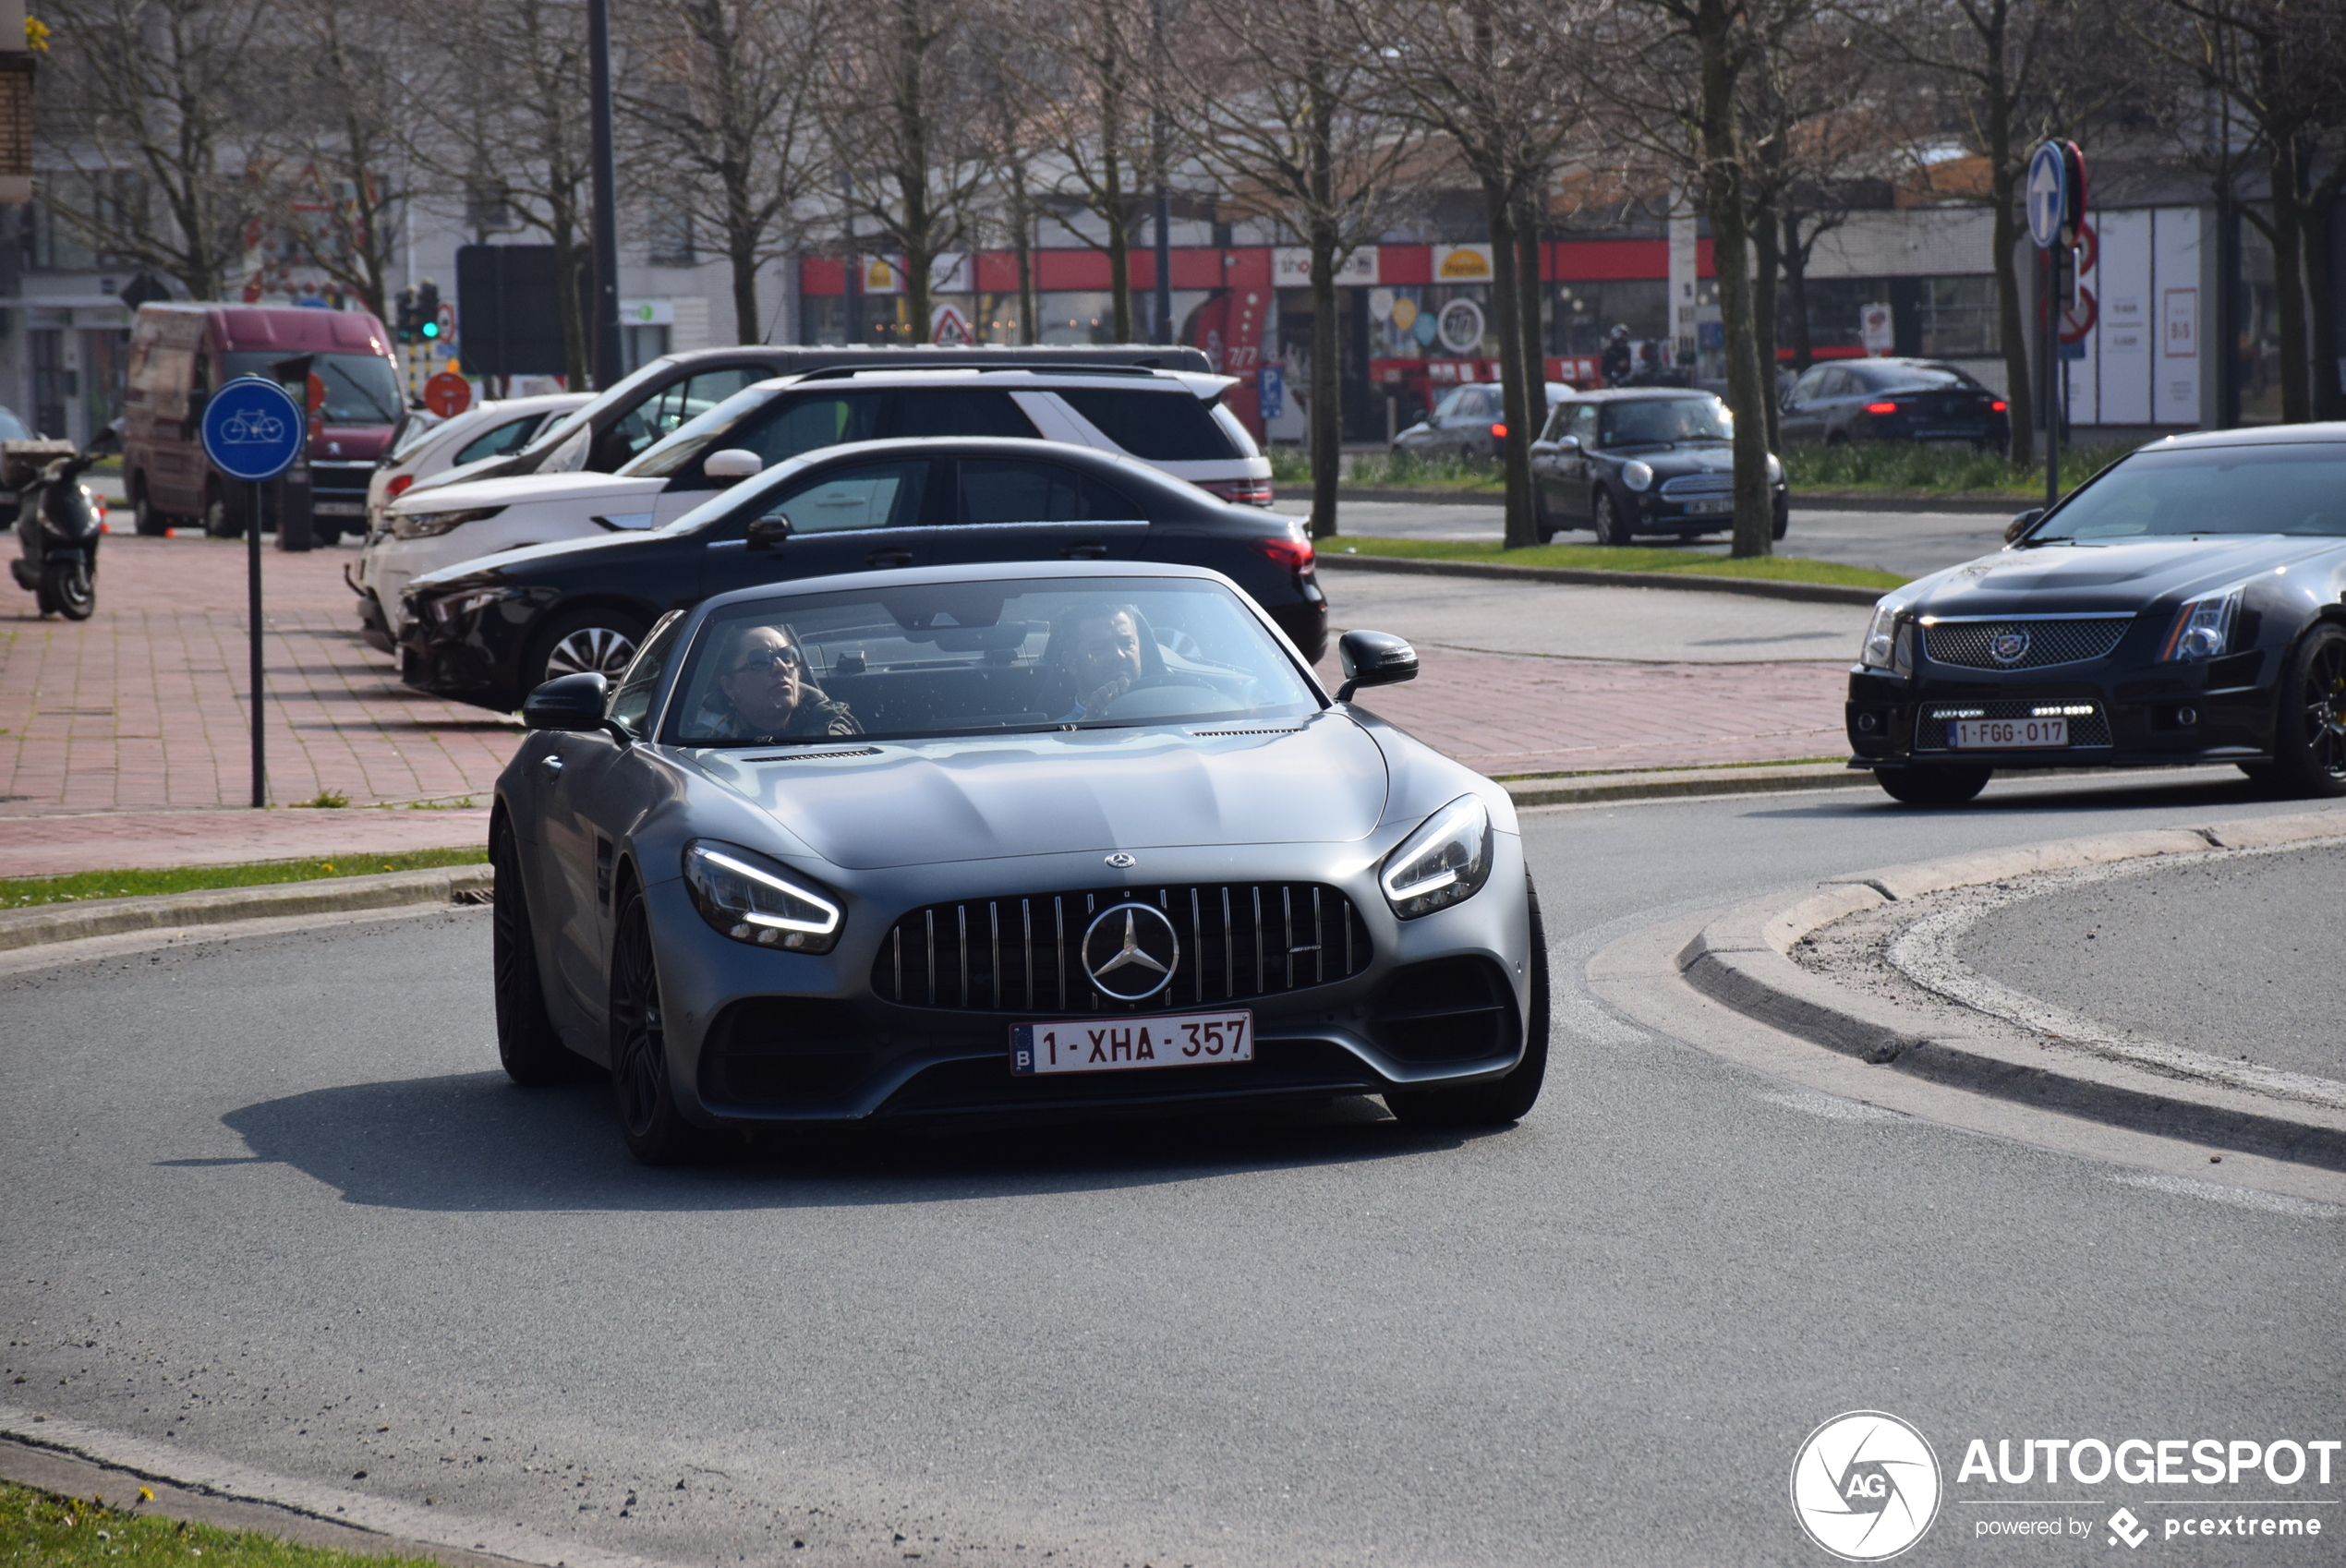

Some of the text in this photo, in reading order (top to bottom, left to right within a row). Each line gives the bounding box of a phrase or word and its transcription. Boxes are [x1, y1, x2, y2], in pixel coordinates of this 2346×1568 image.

[1227, 346, 1258, 368] 7/7
[1264, 371, 1277, 391] P
[1043, 1019, 1246, 1066] 1-XHA-357
[1016, 1050, 1031, 1067] B
